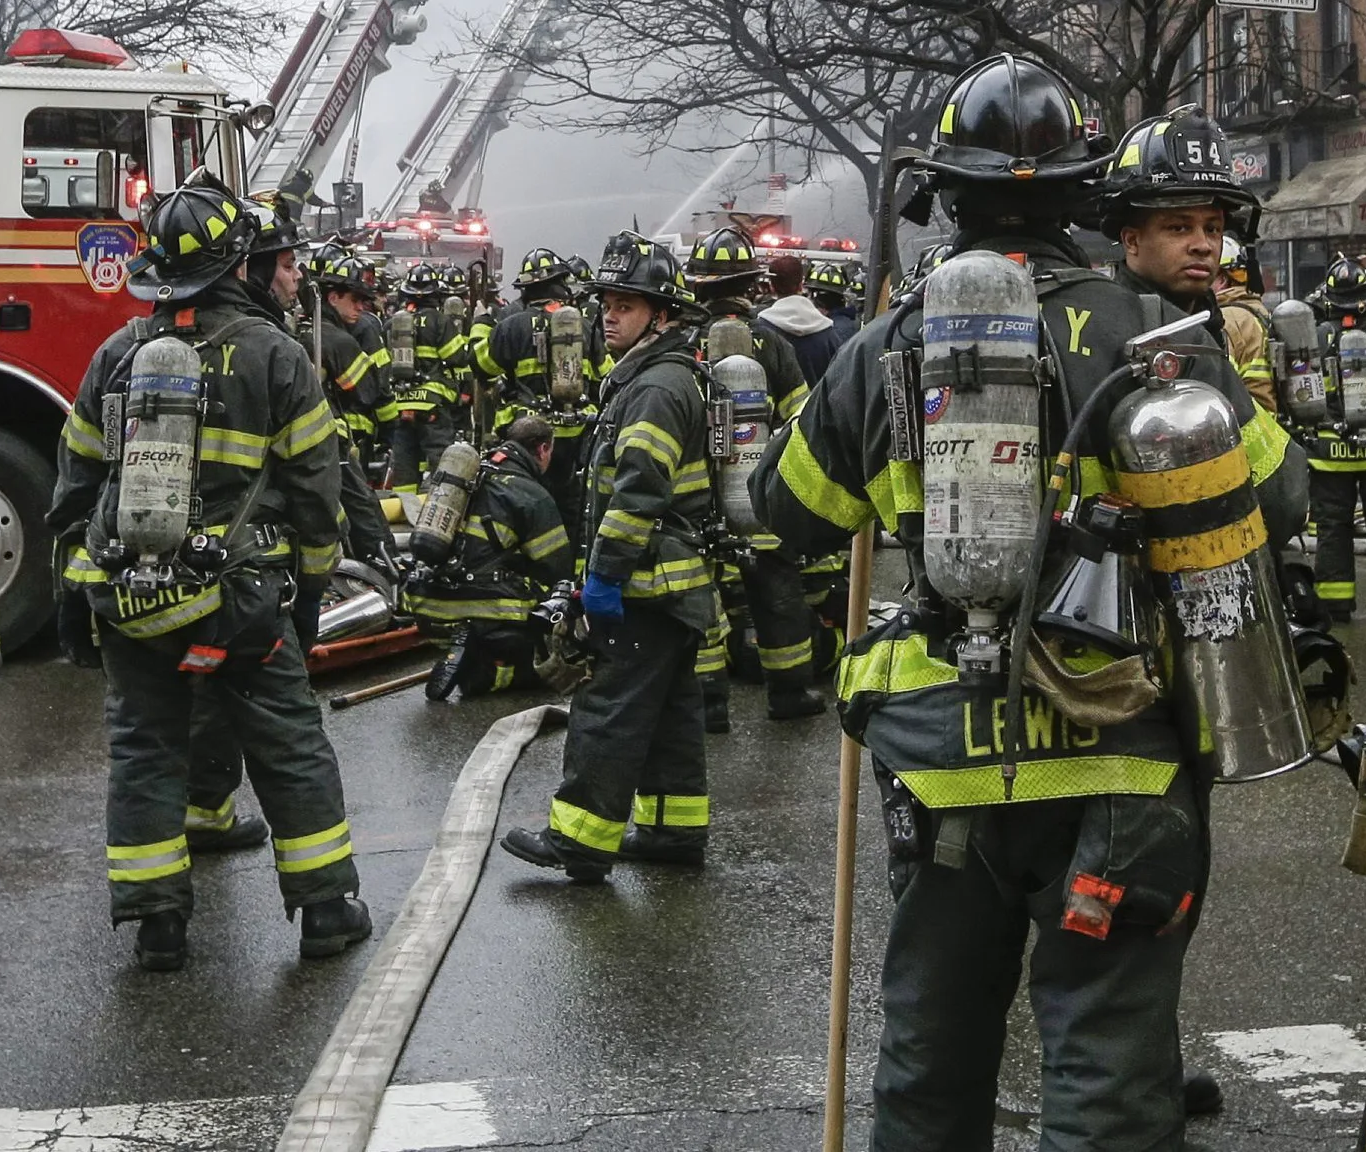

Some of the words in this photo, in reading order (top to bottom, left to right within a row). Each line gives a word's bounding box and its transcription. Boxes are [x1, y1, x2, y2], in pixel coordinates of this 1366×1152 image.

[314, 90, 344, 139] TOWER
[343, 41, 373, 92] LADDER
[368, 23, 381, 44] 18
[1186, 139, 1222, 167] 54
[946, 319, 969, 330] ST7
[1004, 321, 1034, 332] SCOTT
[139, 450, 183, 462] SCOTT
[741, 451, 762, 461] SCO
[924, 439, 976, 458] SCOTT
